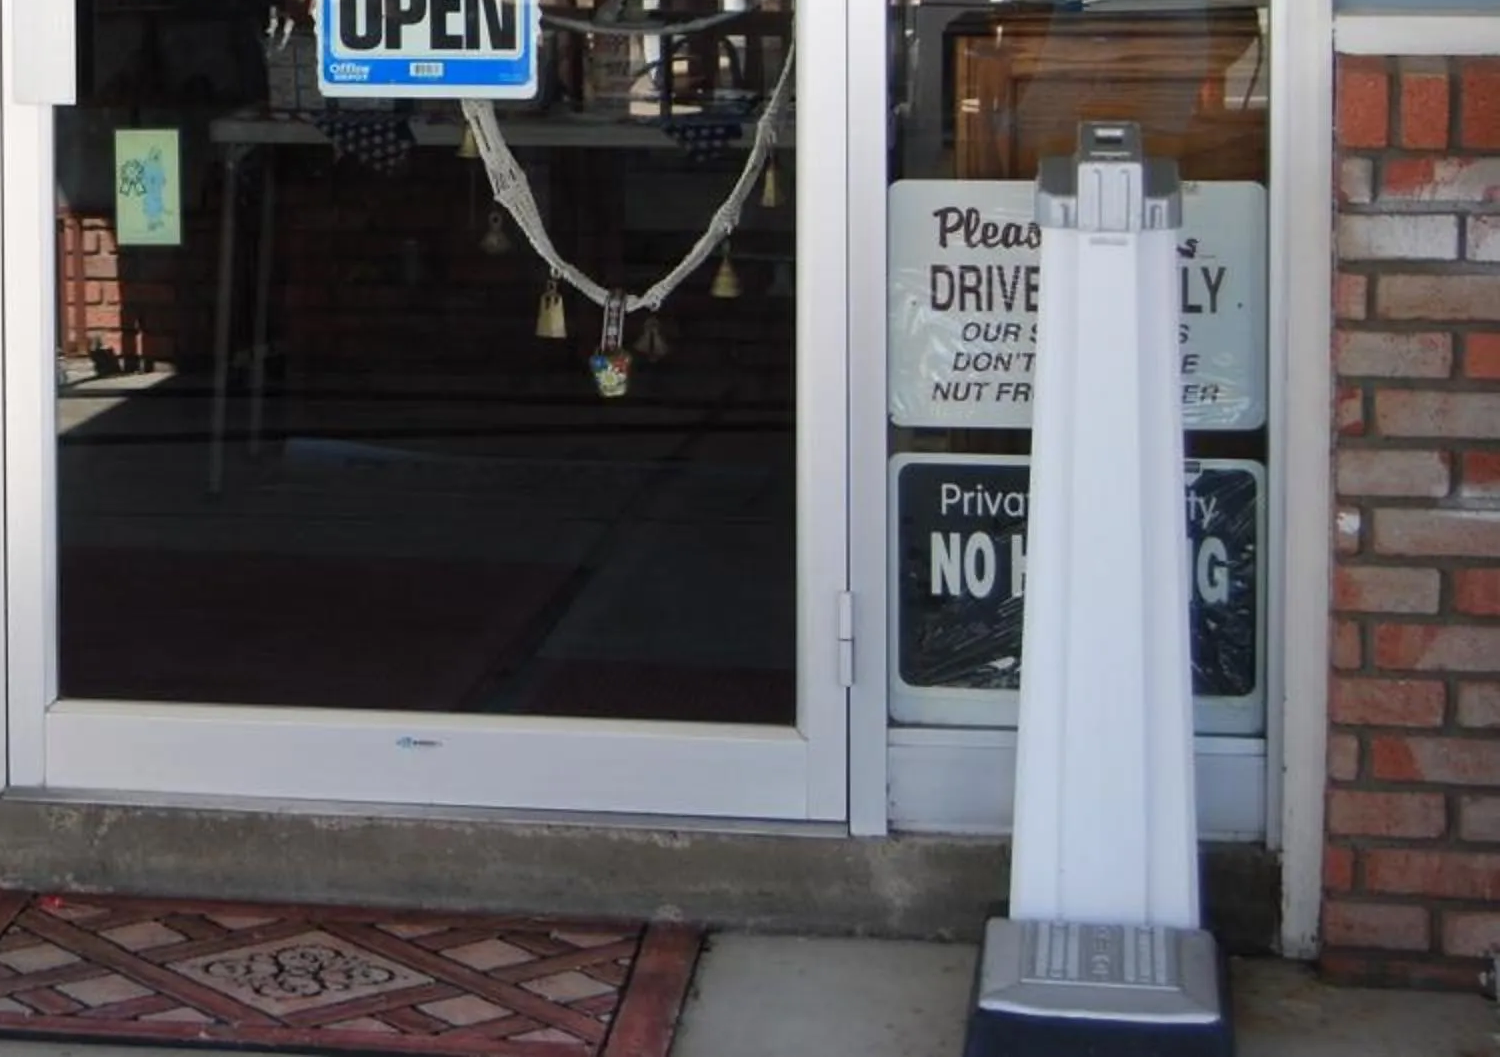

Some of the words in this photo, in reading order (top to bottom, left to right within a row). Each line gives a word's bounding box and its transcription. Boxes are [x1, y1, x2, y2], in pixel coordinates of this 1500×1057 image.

[932, 206, 1042, 249] Pleas
[930, 264, 1040, 312] DRIVE
[962, 321, 1023, 343] OUR
[952, 351, 1035, 372] DON'T
[931, 381, 990, 402] NUT
[941, 483, 1029, 516] Priva
[931, 531, 997, 599] NO
